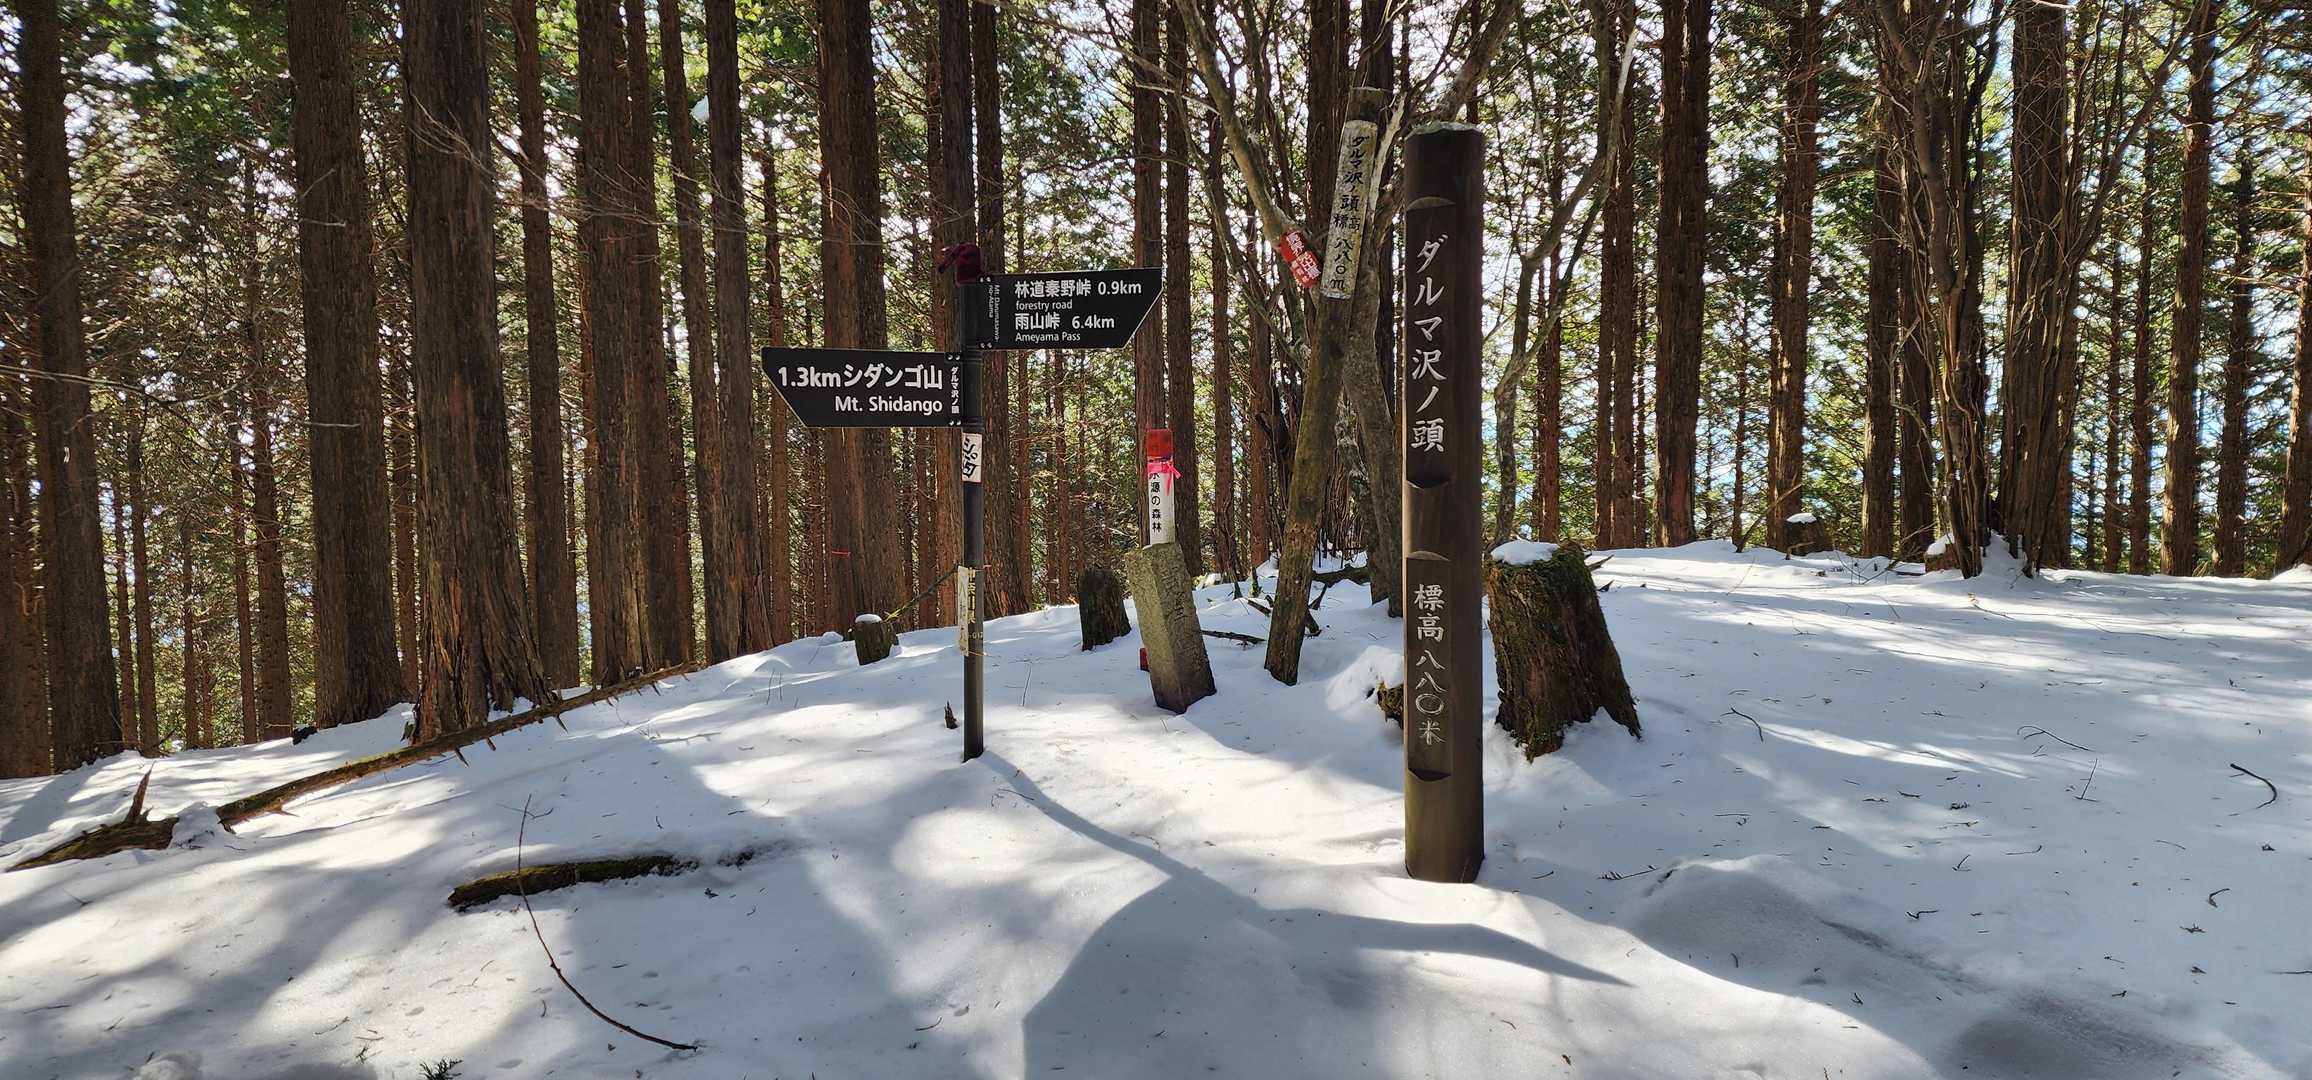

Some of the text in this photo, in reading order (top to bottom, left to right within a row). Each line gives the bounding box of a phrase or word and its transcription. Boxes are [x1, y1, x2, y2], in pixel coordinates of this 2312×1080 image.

[1340, 136, 1369, 211] ダルマ沢ノ頭
[1015, 279, 1142, 298] 林道秦野峠 0.9km
[1016, 299, 1073, 312] forestry road
[1015, 311, 1115, 330] 雨山峠 6.4km
[1015, 331, 1081, 344] Ameyama Pass
[1411, 234, 1449, 453] ダルマ沢ノ頭
[835, 395, 943, 415] Mt. Shidango
